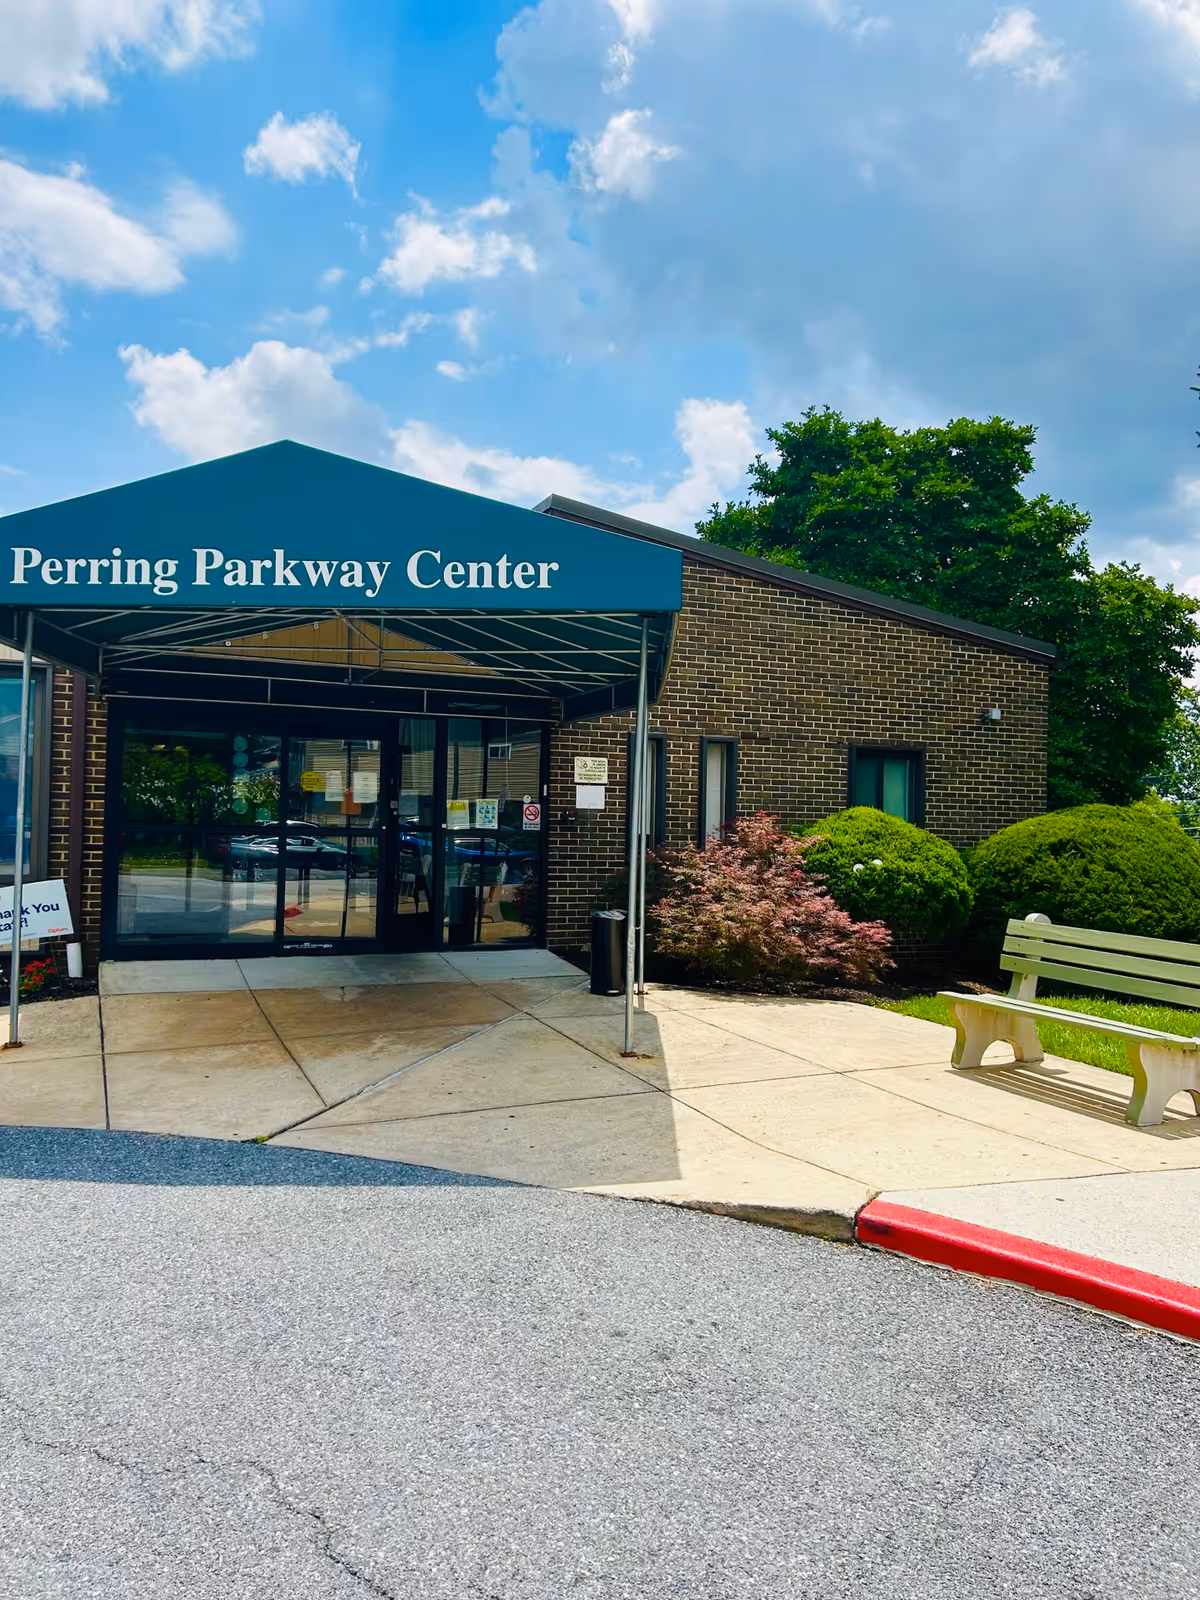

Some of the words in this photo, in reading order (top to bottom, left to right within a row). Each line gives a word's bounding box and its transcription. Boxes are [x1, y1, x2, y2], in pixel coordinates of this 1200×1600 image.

[9, 547, 179, 596] Perring
[191, 548, 392, 598] Parkway
[406, 549, 560, 589] Center
[32, 902, 60, 914] You
